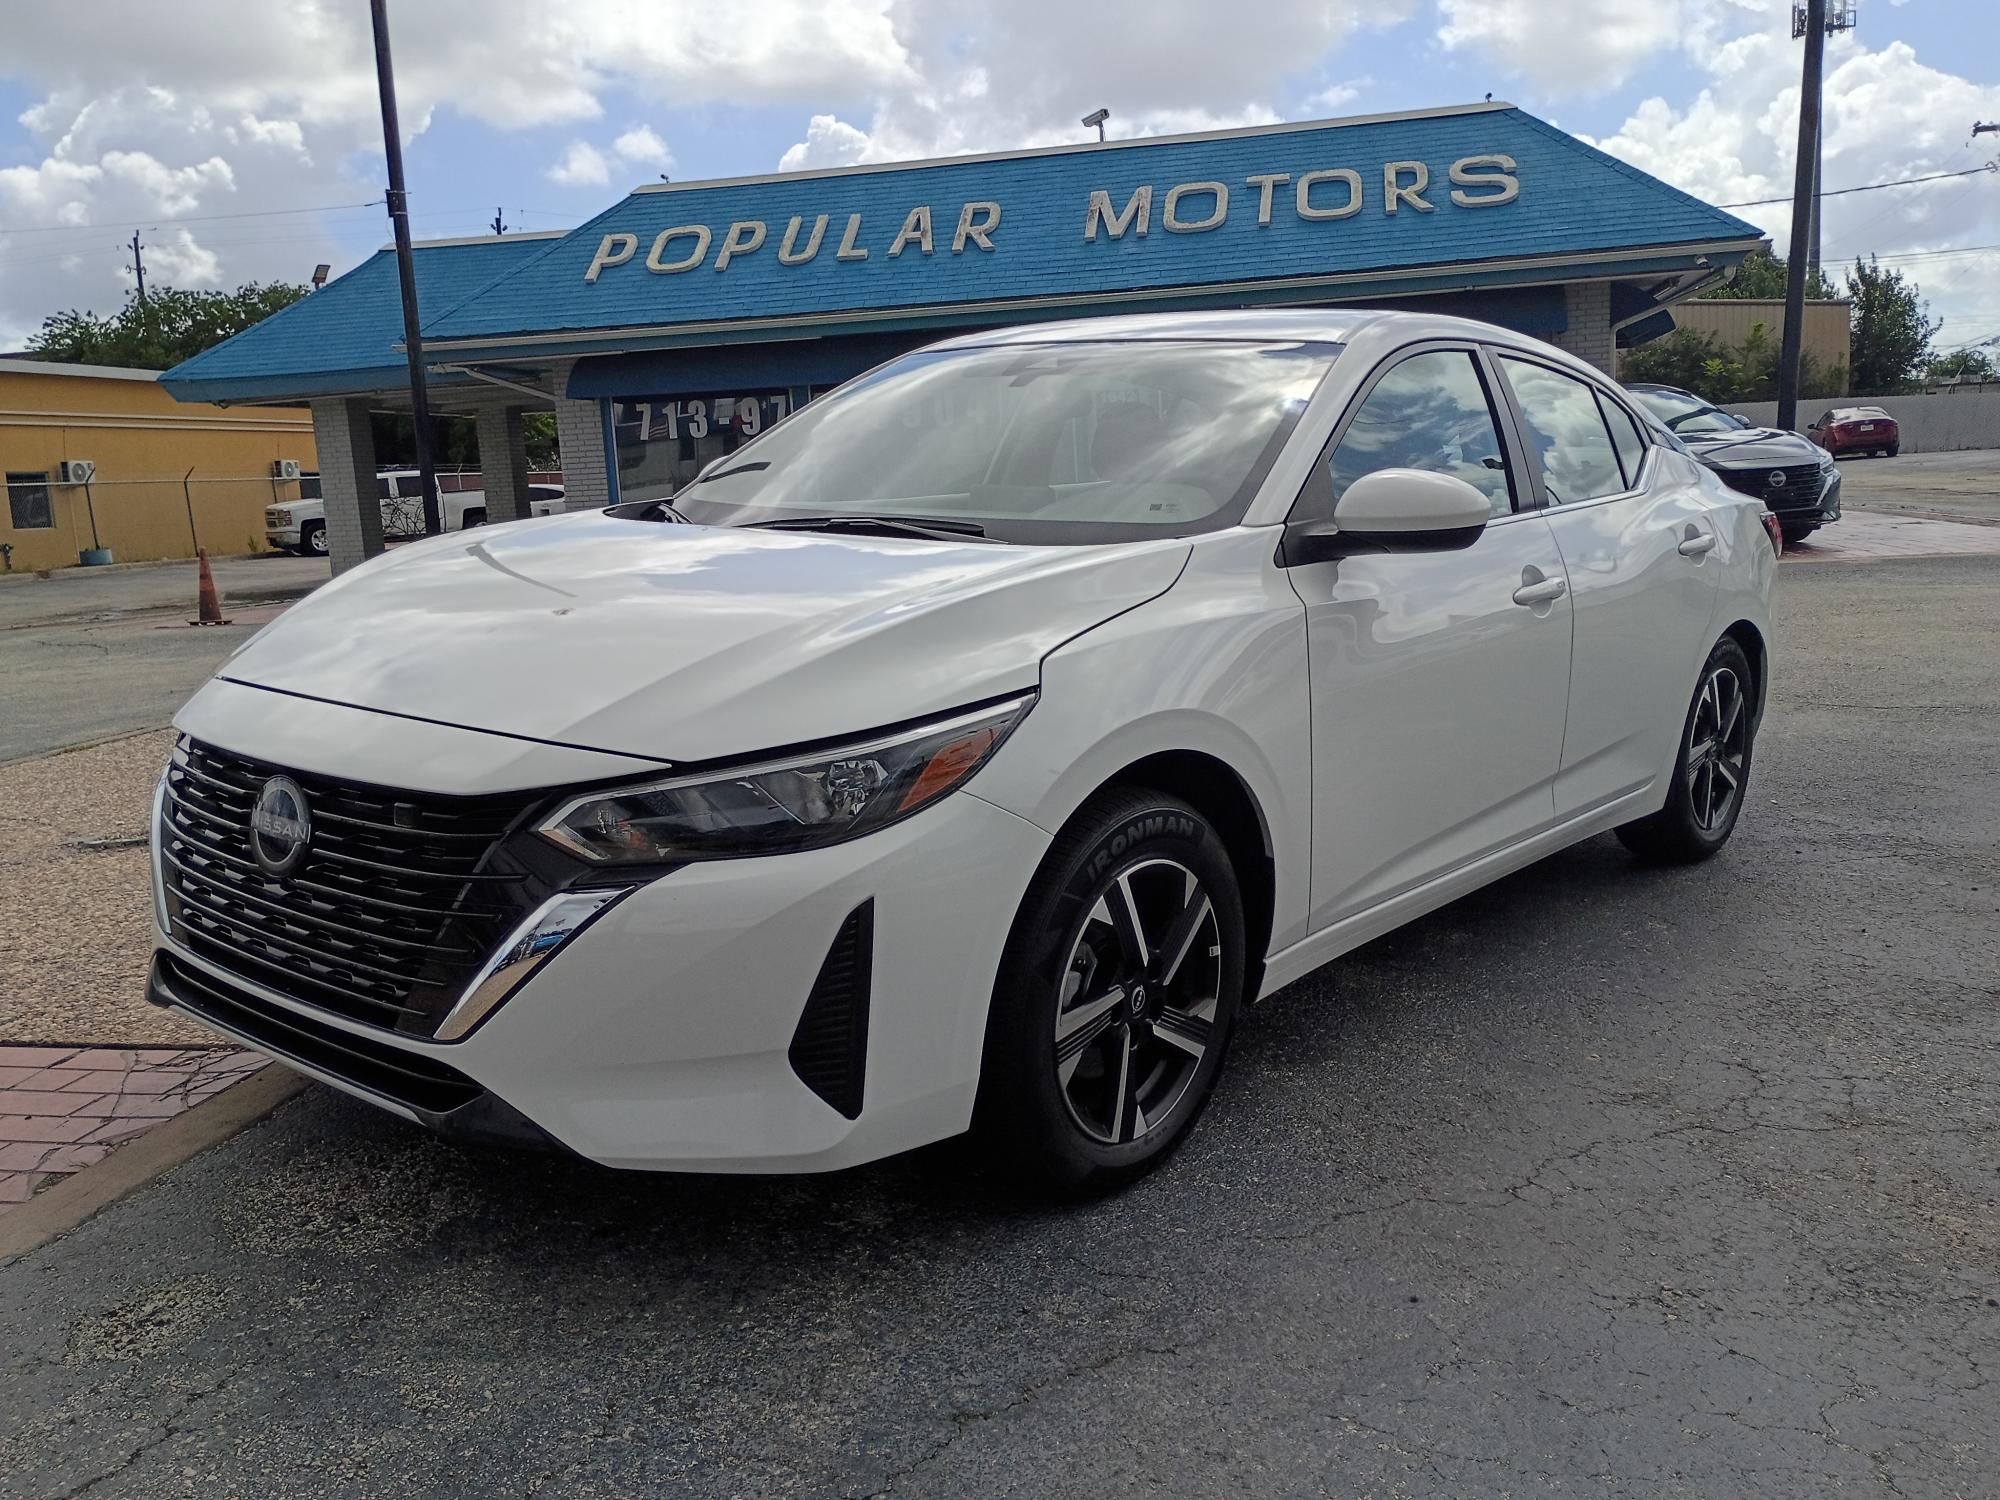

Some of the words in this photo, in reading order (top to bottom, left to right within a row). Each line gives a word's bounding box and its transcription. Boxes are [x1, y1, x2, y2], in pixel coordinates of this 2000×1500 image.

[584, 201, 1002, 283] POPULAR
[1084, 154, 1520, 242] MOTORS
[636, 392, 823, 441] 713-97
[252, 811, 307, 840] NISSAN
[1087, 816, 1194, 882] IRONMAN
